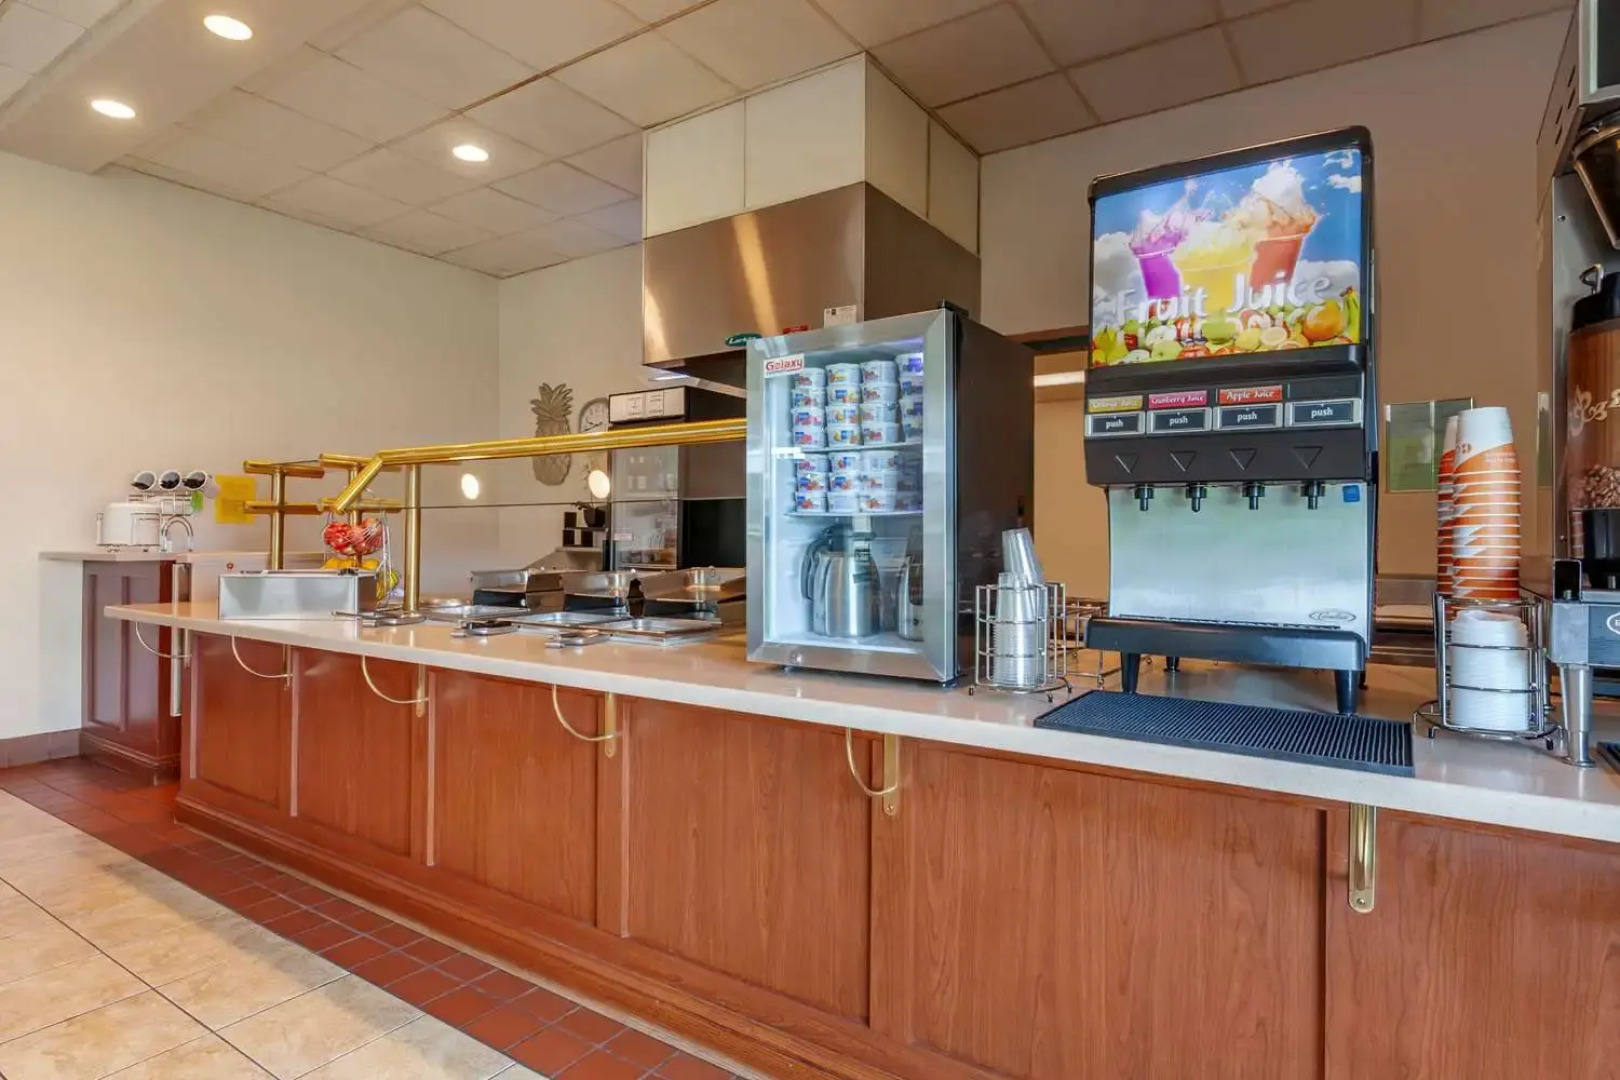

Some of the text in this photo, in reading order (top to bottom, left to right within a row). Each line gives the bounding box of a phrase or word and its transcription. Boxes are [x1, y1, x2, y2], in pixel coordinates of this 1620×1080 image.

[1115, 270, 1331, 329] Fruit Juice
[766, 359, 803, 371] Galaxy
[1226, 390, 1275, 401] Apple Juice
[1237, 411, 1258, 423] push
[1310, 407, 1333, 419] push
[1105, 419, 1124, 430] push
[1168, 416, 1189, 428] push
